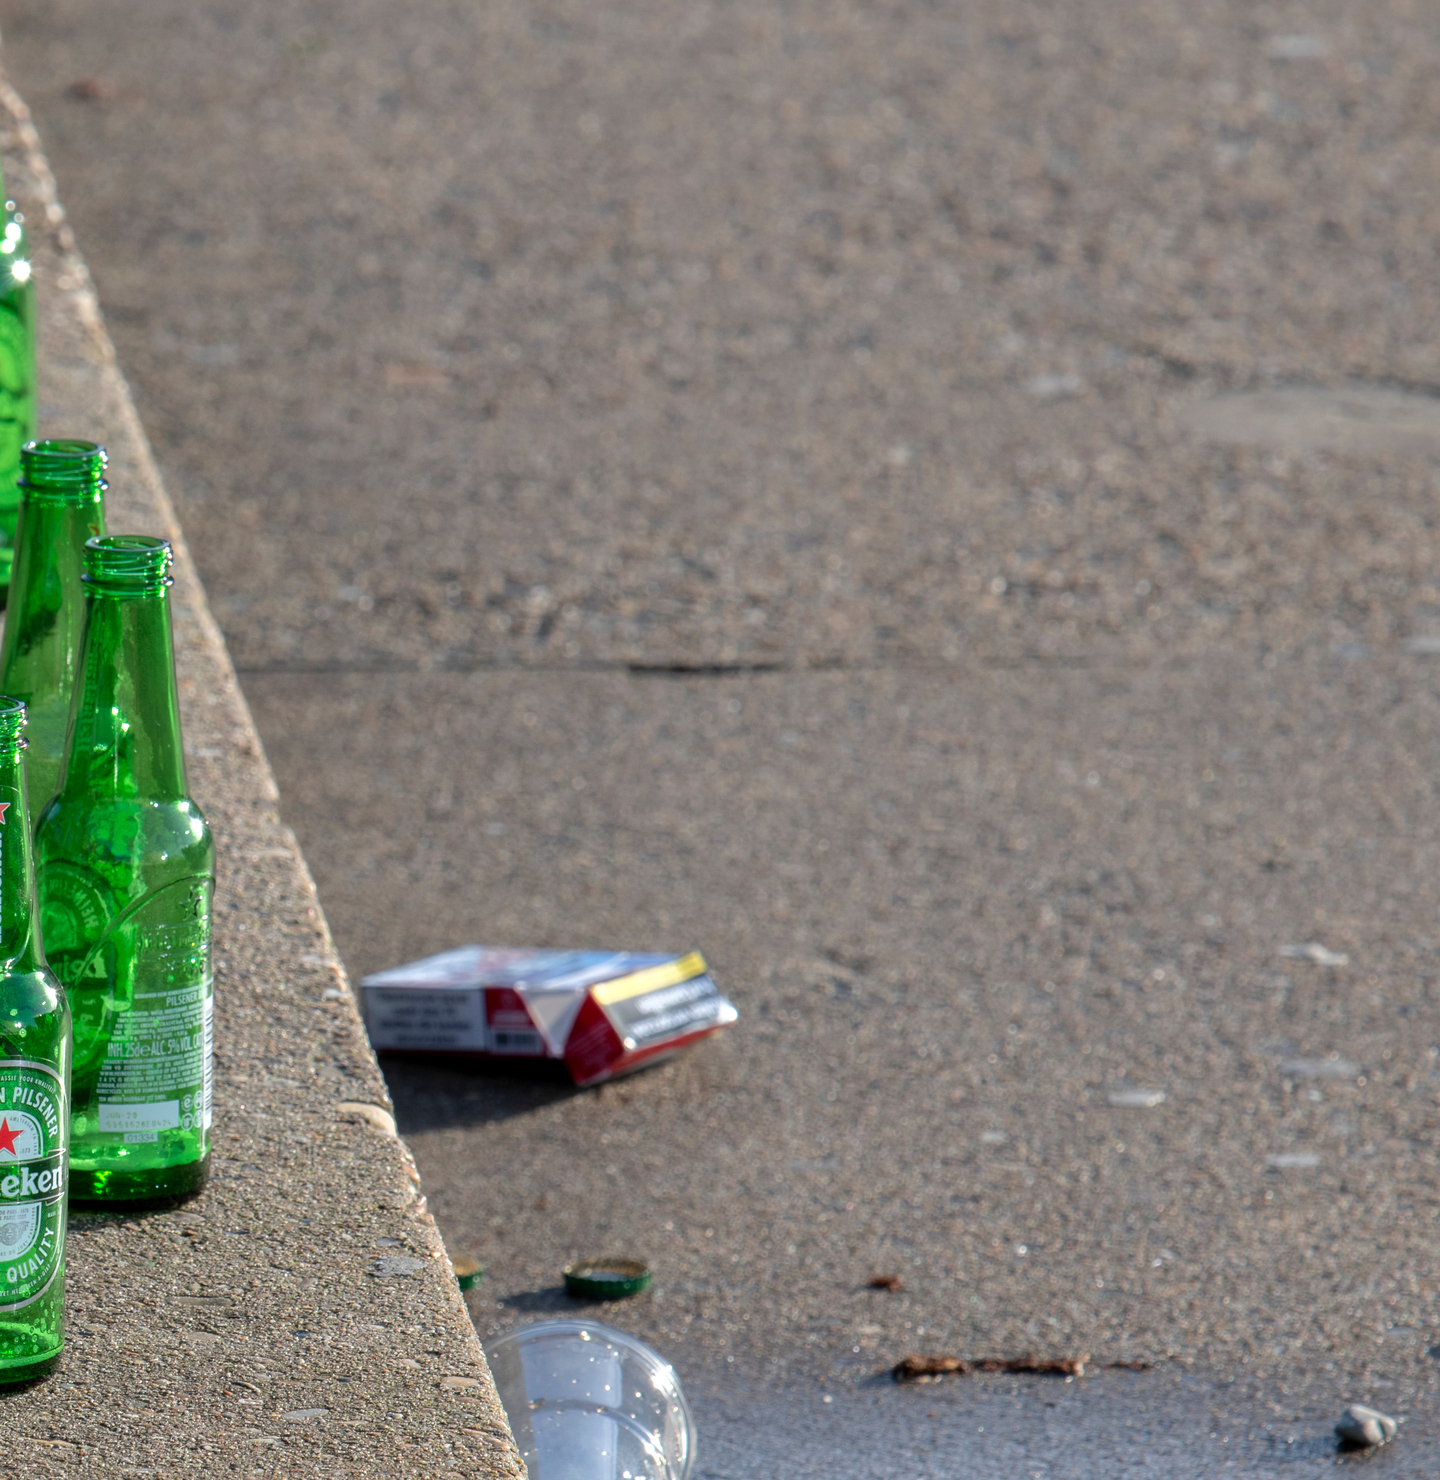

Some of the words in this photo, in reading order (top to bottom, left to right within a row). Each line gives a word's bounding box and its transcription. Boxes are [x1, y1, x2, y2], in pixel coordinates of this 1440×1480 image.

[166, 991, 198, 1007] PILSENER
[12, 1086, 59, 1138] PILSENER
[127, 1133, 155, 1143] 01334
[6, 1226, 55, 1283] QUALITY
[11, 1279, 37, 1296] HEKEN
